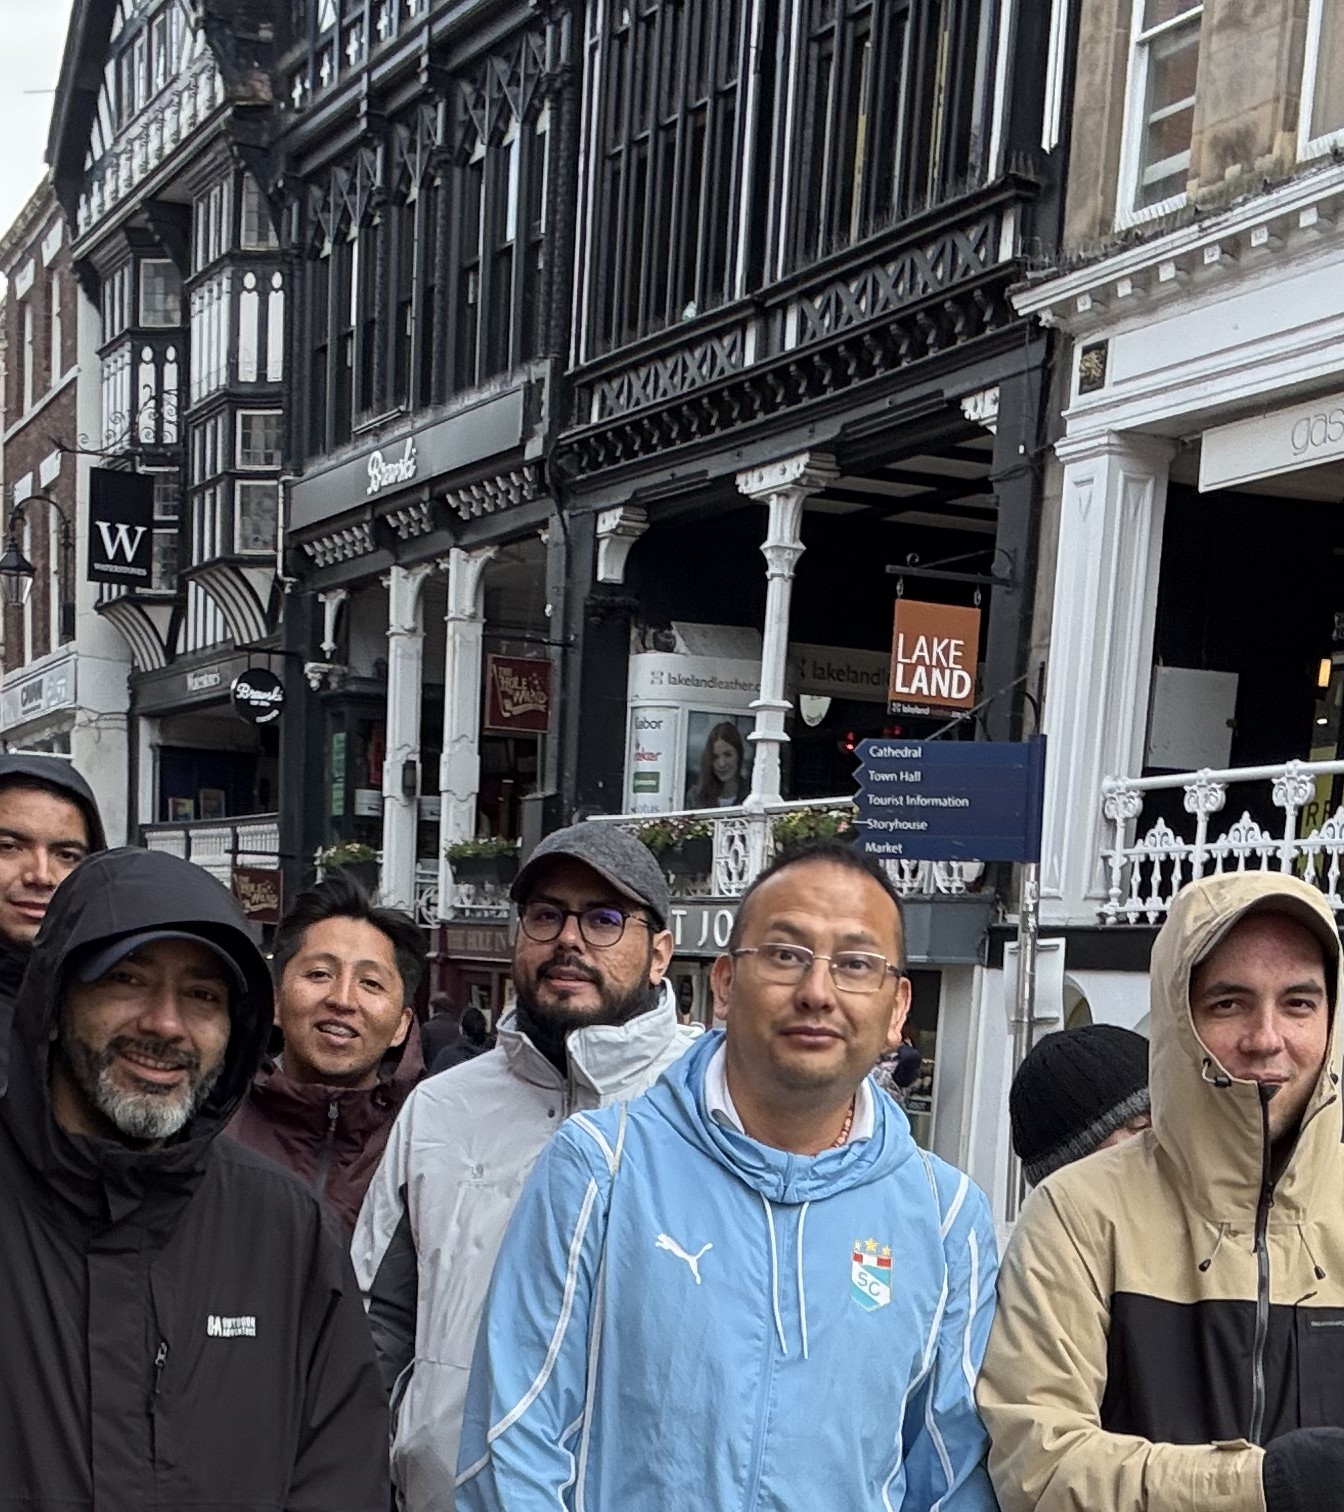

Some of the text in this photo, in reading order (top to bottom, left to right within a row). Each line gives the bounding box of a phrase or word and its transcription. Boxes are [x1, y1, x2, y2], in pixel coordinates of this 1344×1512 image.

[95, 520, 147, 564] W
[897, 632, 965, 670] LAKE
[895, 662, 972, 699] LAND
[868, 745, 922, 759] Cathedral
[868, 770, 922, 783] Town Hall
[867, 794, 970, 808] Tourist Information
[866, 818, 928, 833] Storyhouse
[864, 842, 903, 854] Market
[857, 1271, 881, 1297] SC
